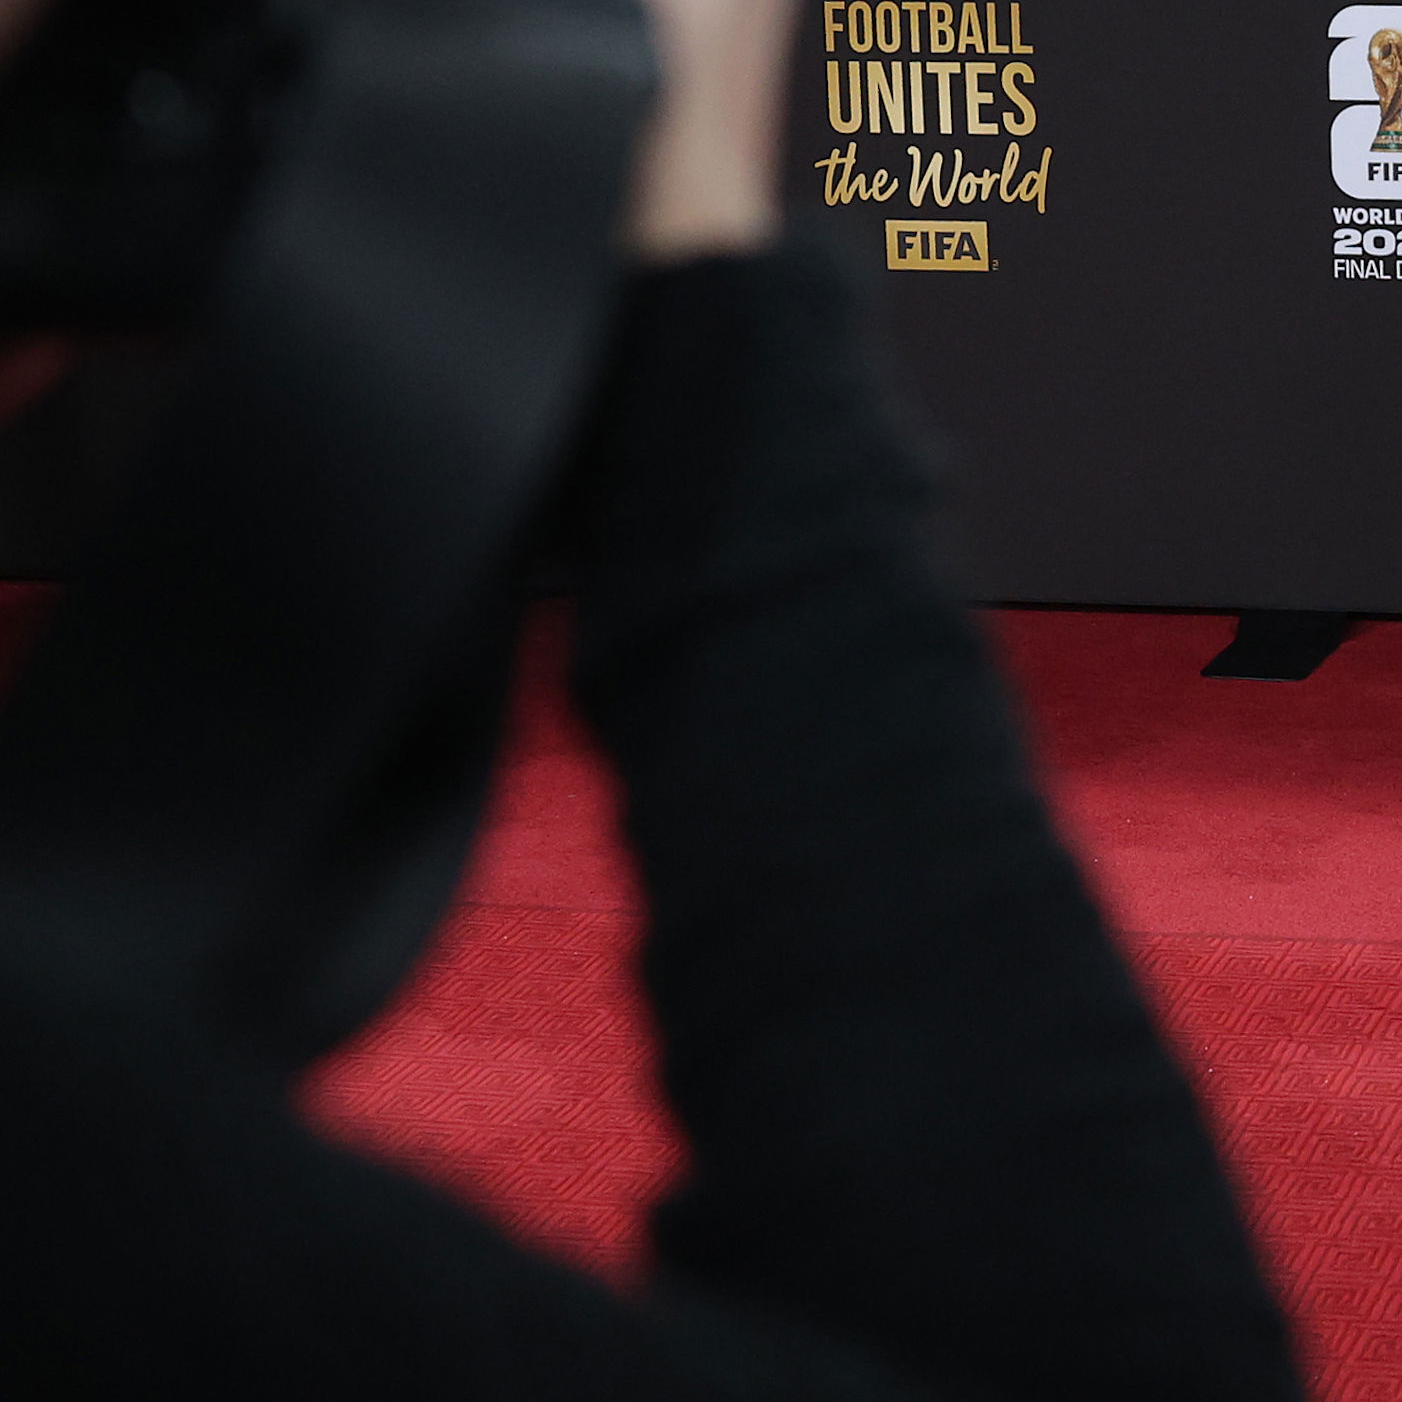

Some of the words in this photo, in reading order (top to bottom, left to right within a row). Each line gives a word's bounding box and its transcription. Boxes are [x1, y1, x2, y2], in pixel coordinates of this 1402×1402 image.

[824, 1, 1033, 54] FOOTBALL
[827, 61, 1036, 135] UNITES
[815, 142, 898, 206] the
[908, 142, 1052, 213] World
[897, 231, 981, 260] FIFA
[1334, 259, 1391, 279] FINAL
